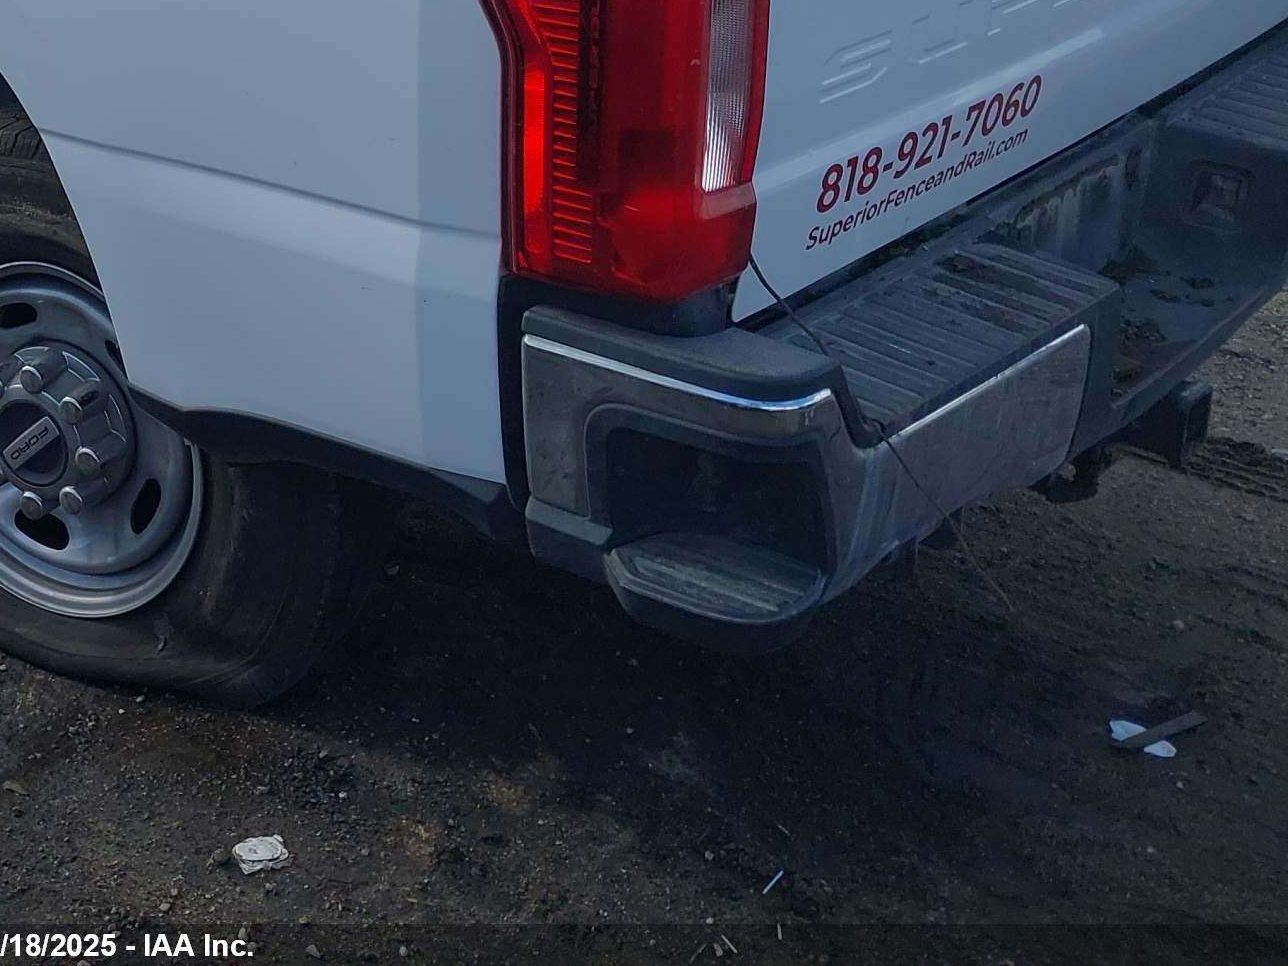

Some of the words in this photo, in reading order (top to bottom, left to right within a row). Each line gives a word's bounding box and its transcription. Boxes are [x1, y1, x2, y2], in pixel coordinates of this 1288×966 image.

[805, 128, 1029, 251] SuperiorFenceandRail.com
[815, 74, 1043, 214] 818-921-7060
[10, 426, 49, 460] FORD
